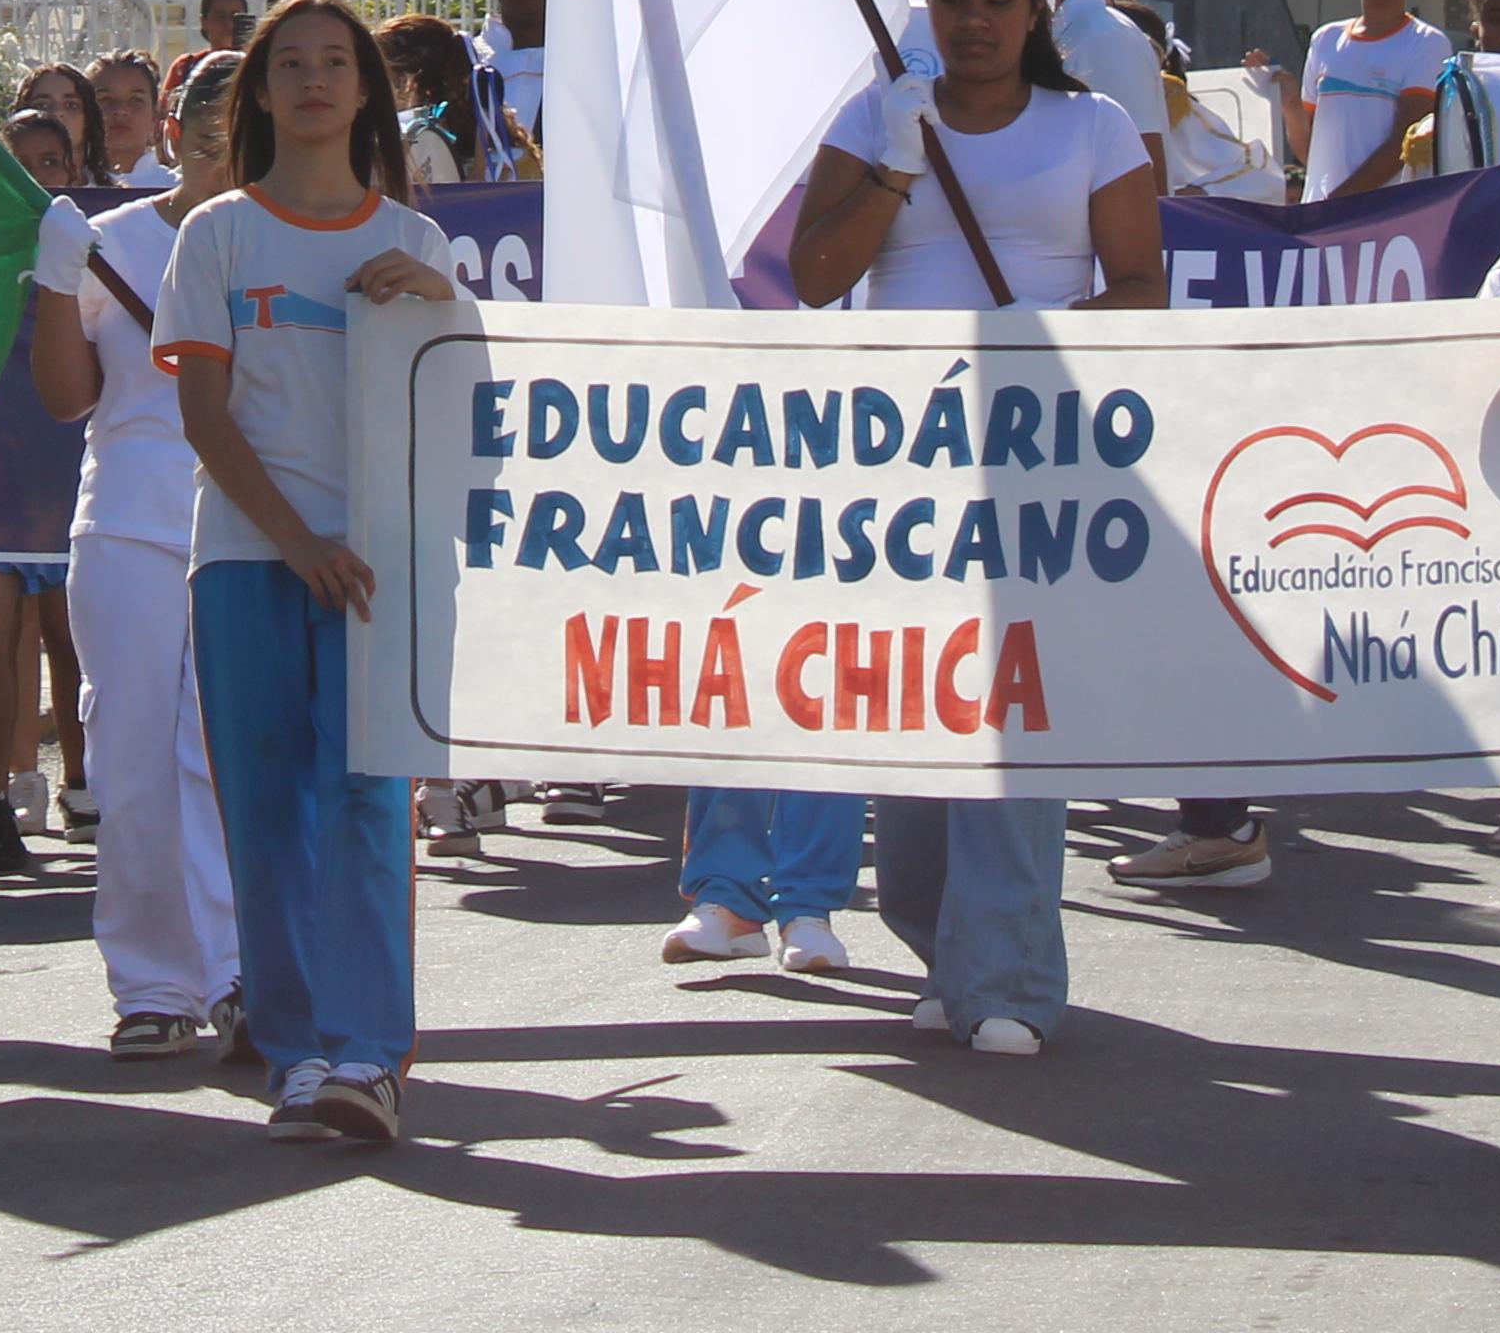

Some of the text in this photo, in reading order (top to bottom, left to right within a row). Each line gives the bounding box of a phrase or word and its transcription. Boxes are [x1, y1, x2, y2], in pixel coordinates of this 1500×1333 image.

[471, 357, 1154, 471] EDUCANDÁRIO
[465, 488, 1151, 585] FRANCISCANO
[1229, 552, 1393, 595] Educandário
[564, 583, 1051, 735] NHÁ CHICA
[1323, 606, 1418, 686] Nhá
